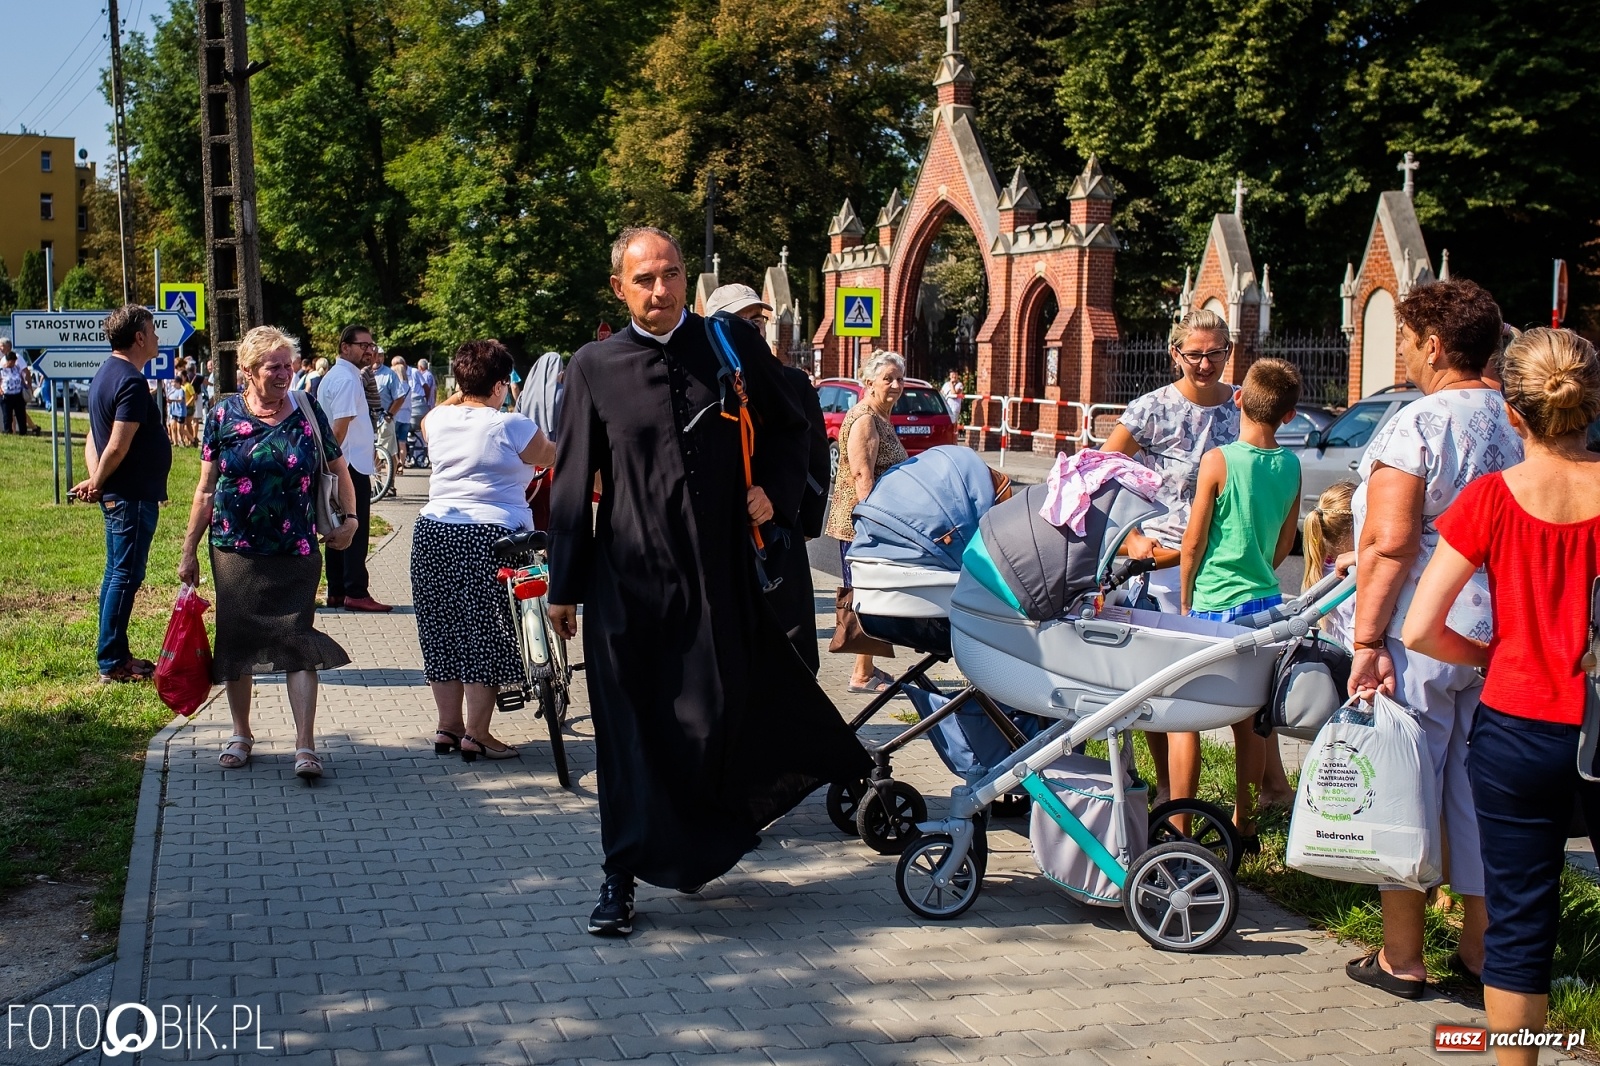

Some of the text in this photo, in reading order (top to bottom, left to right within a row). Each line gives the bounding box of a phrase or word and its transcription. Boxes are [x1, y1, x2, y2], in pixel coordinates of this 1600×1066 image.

[25, 319, 96, 329] STAROSTWO
[59, 332, 106, 342] W RACIB
[53, 360, 100, 368] Dla klientów
[150, 353, 168, 377] P
[1315, 829, 1364, 841] Biedronka
